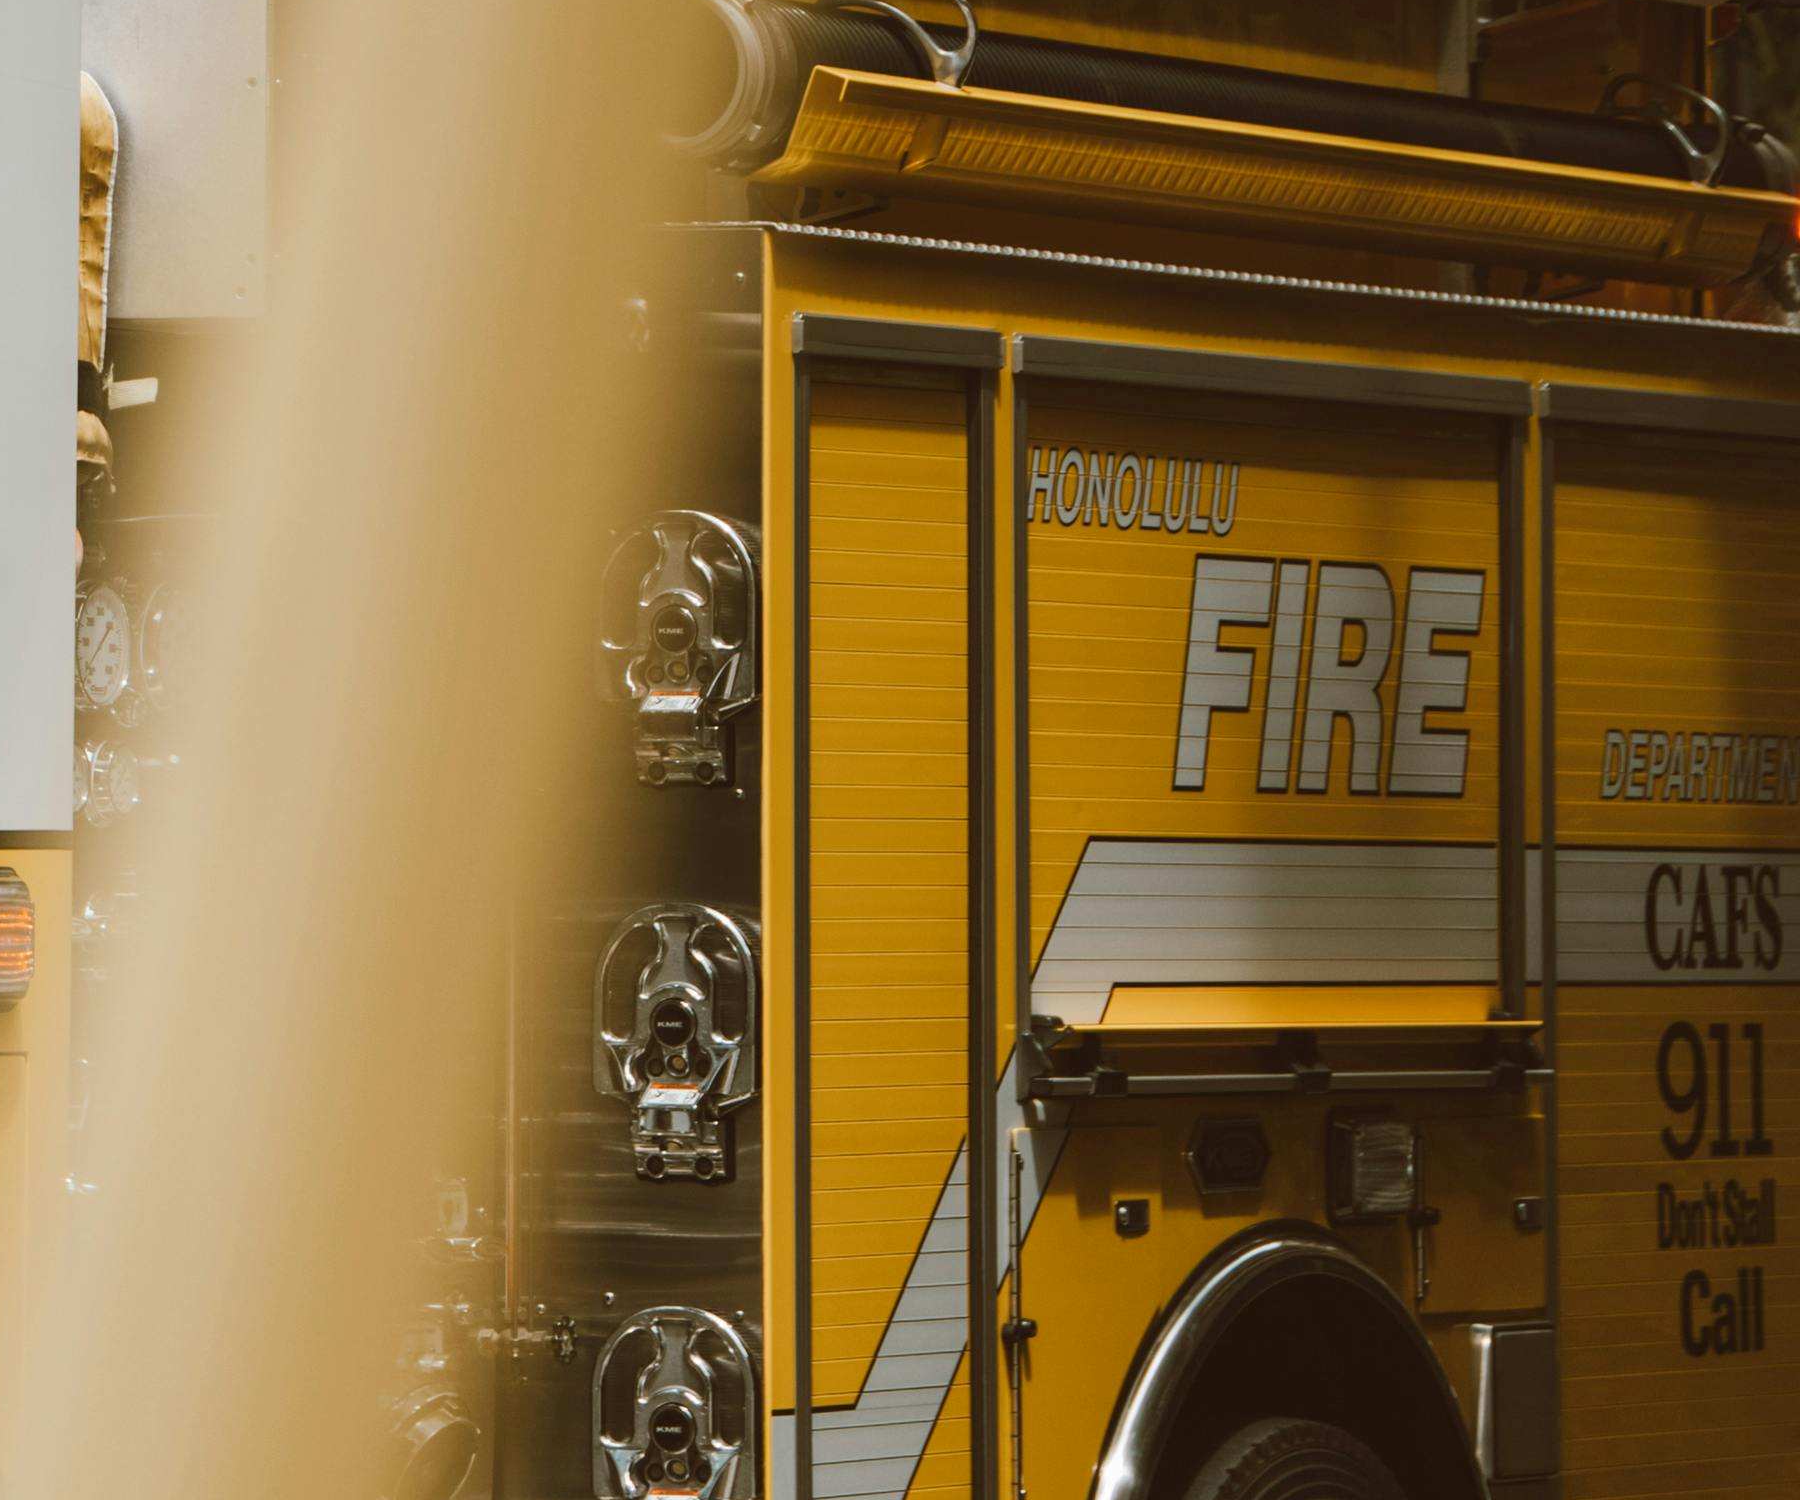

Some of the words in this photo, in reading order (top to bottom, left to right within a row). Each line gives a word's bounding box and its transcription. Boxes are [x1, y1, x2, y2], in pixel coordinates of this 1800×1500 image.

[1027, 446, 1240, 537] HONOLULU
[1171, 553, 1487, 798] FIRE
[1645, 862, 1783, 971] CAFS
[656, 1021, 685, 1029] KME
[1656, 1020, 1774, 1161] 911
[1656, 1180, 1721, 1250] Don't
[1680, 1265, 1766, 1359] Call
[655, 1426, 682, 1434] KME
